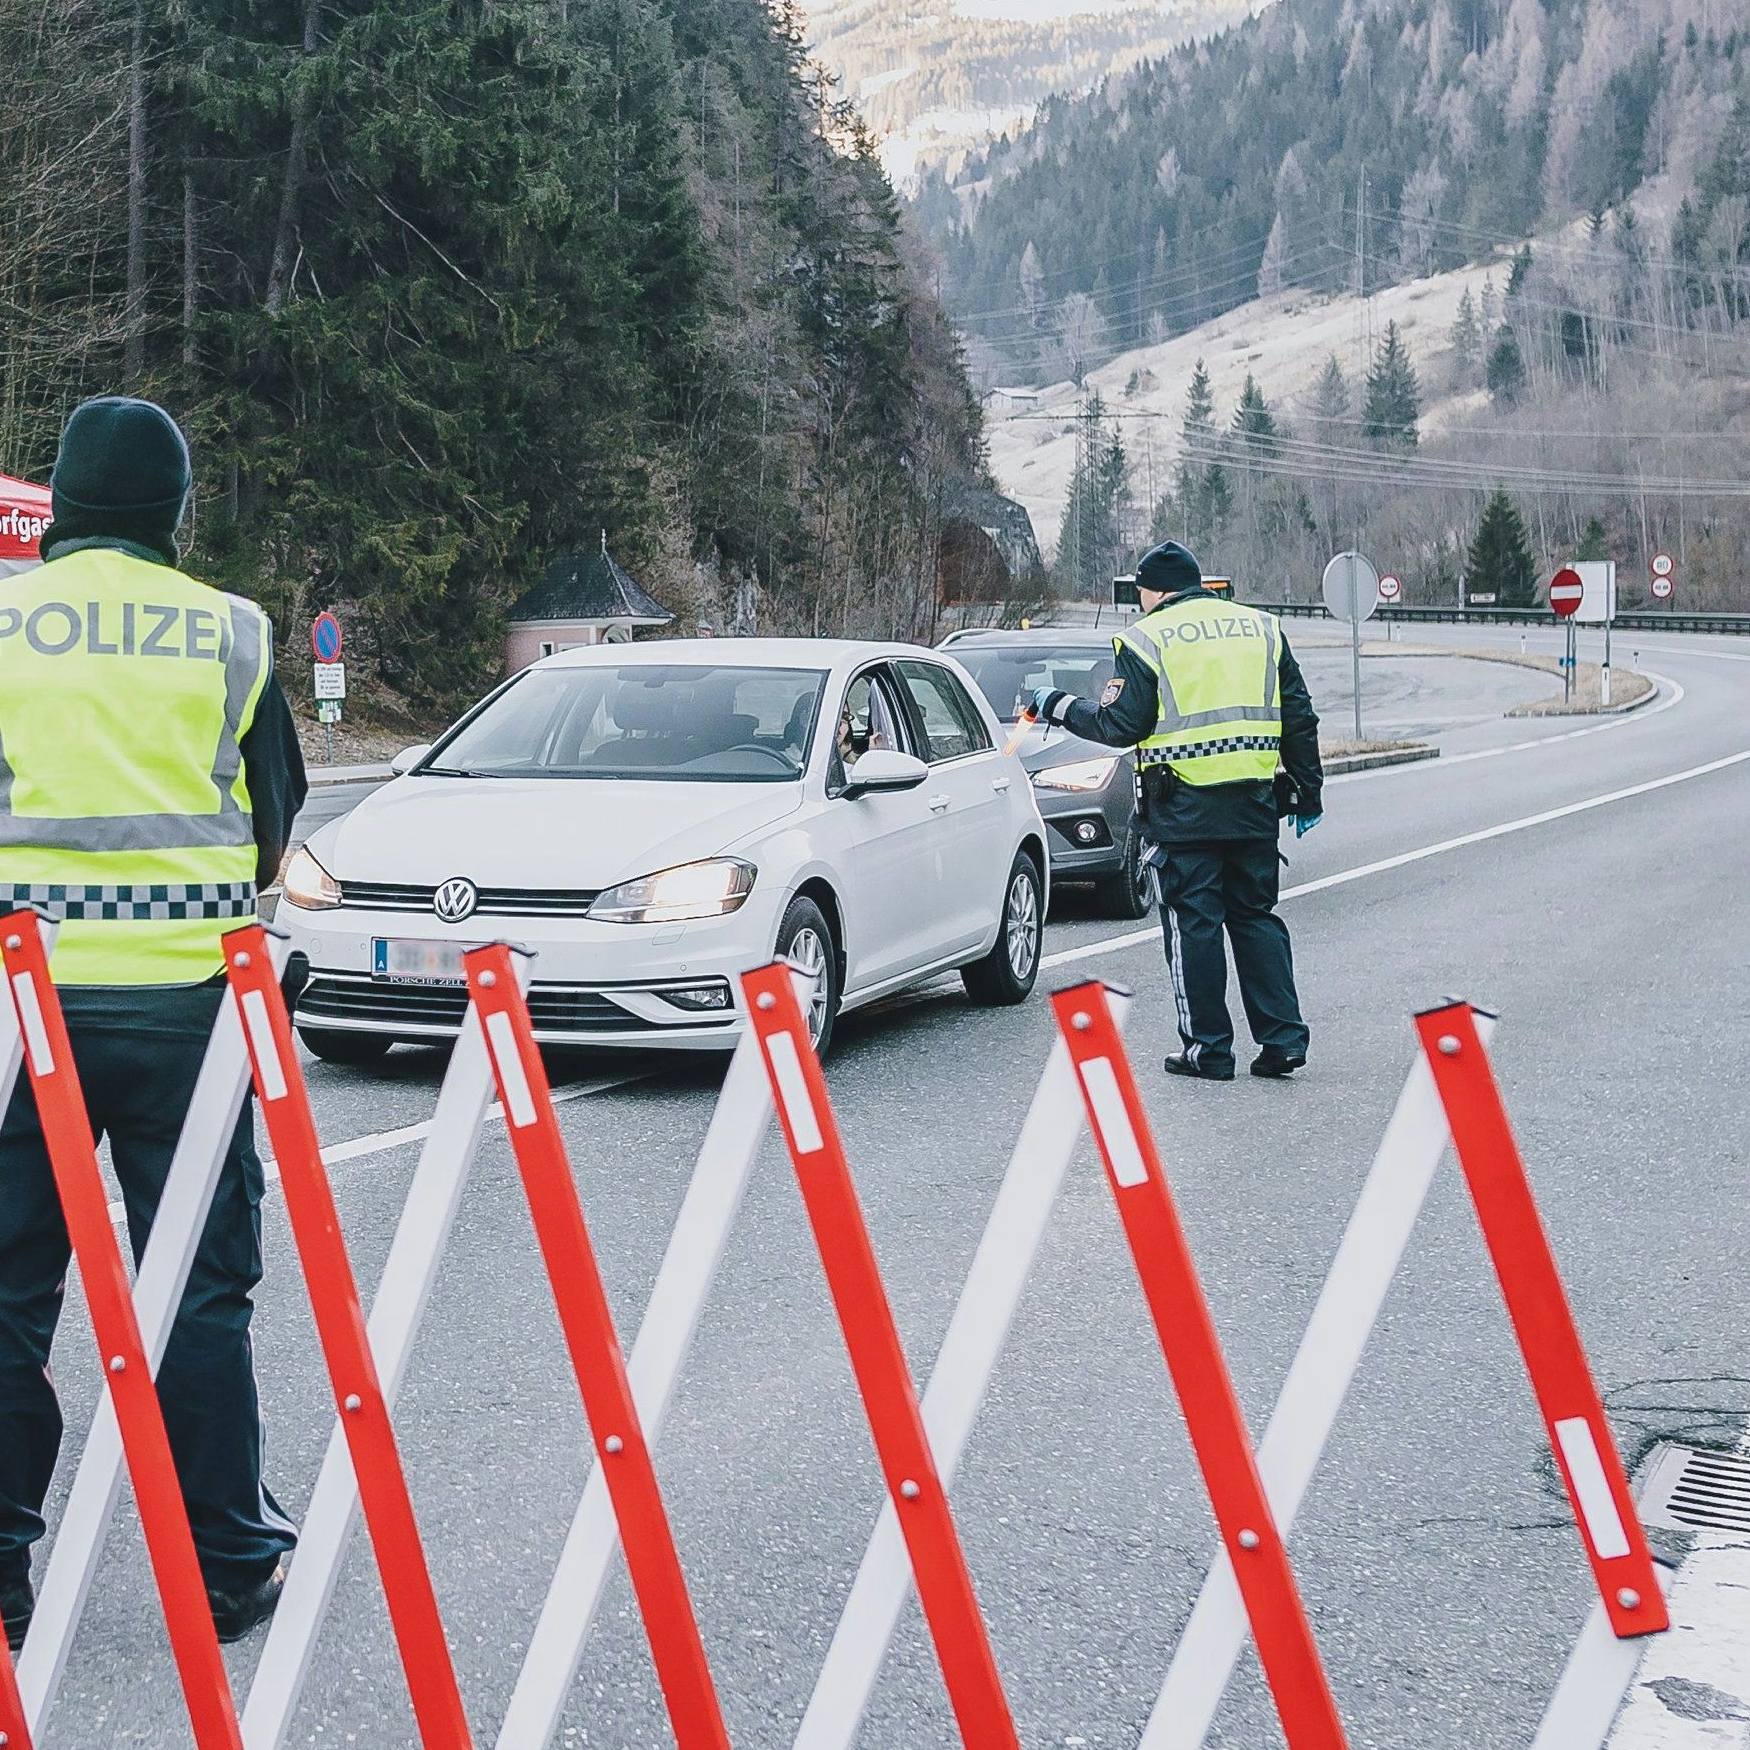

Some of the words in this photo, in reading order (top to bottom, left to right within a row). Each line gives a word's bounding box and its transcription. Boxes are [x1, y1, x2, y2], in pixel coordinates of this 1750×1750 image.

[1158, 618, 1261, 649] POLIZEI
[377, 960, 386, 969] A
[390, 976, 437, 985] PORSCHE
[439, 978, 463, 987] ZELL
